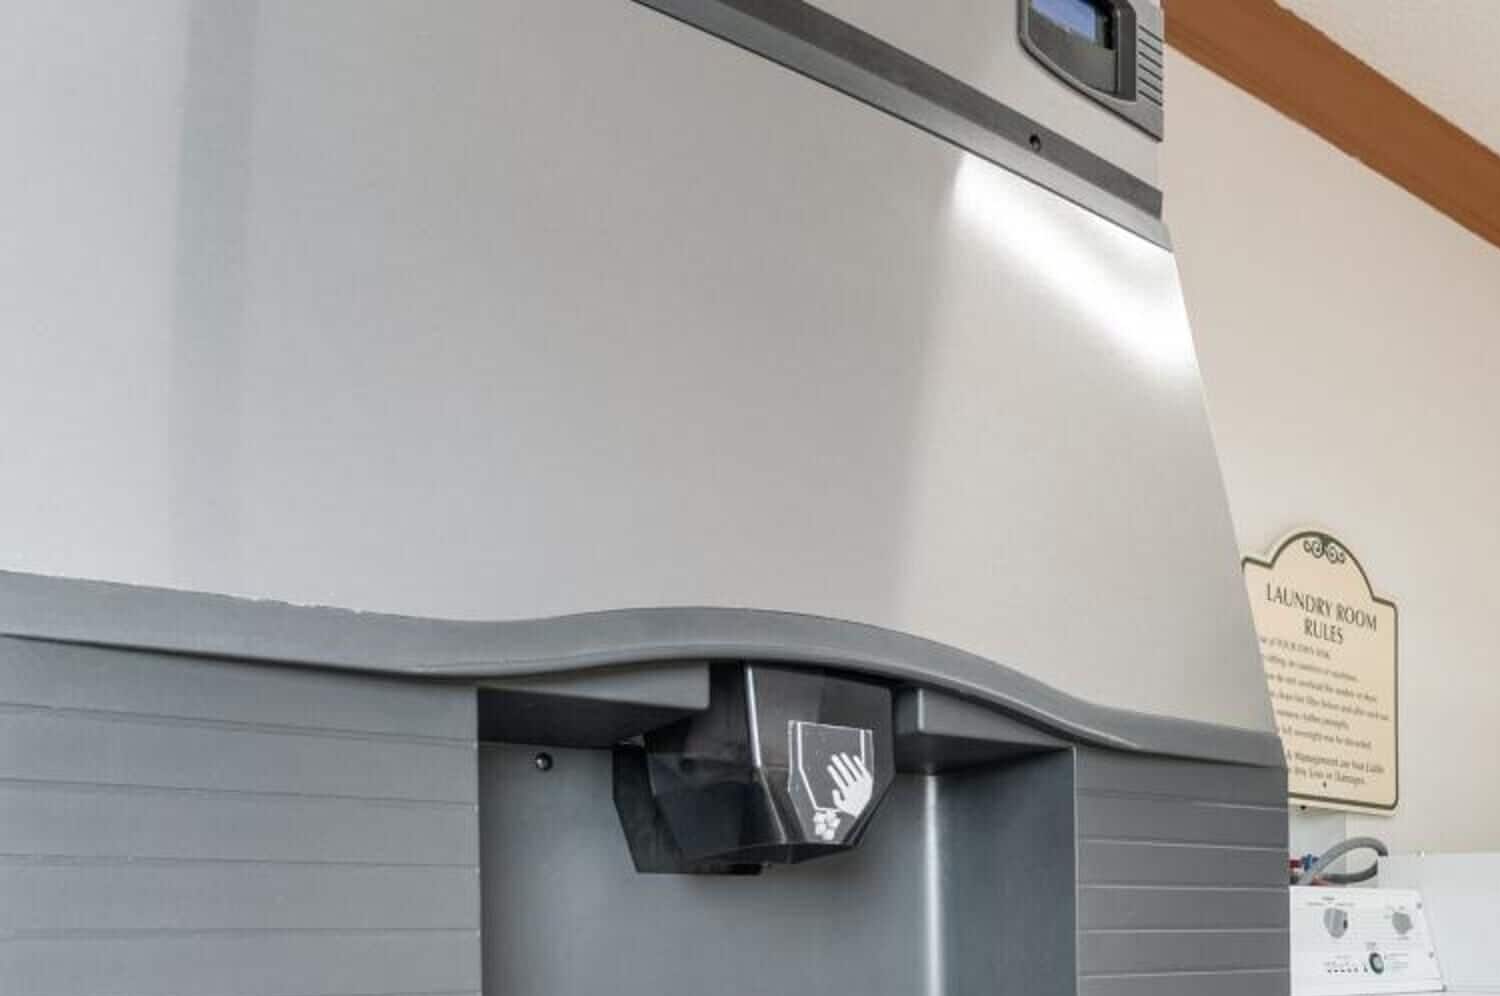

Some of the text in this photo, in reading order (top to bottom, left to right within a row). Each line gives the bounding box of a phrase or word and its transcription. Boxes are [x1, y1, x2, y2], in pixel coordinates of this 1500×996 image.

[1266, 582, 1377, 631] LAUNDRY ROOM
[1303, 616, 1344, 645] RULES
